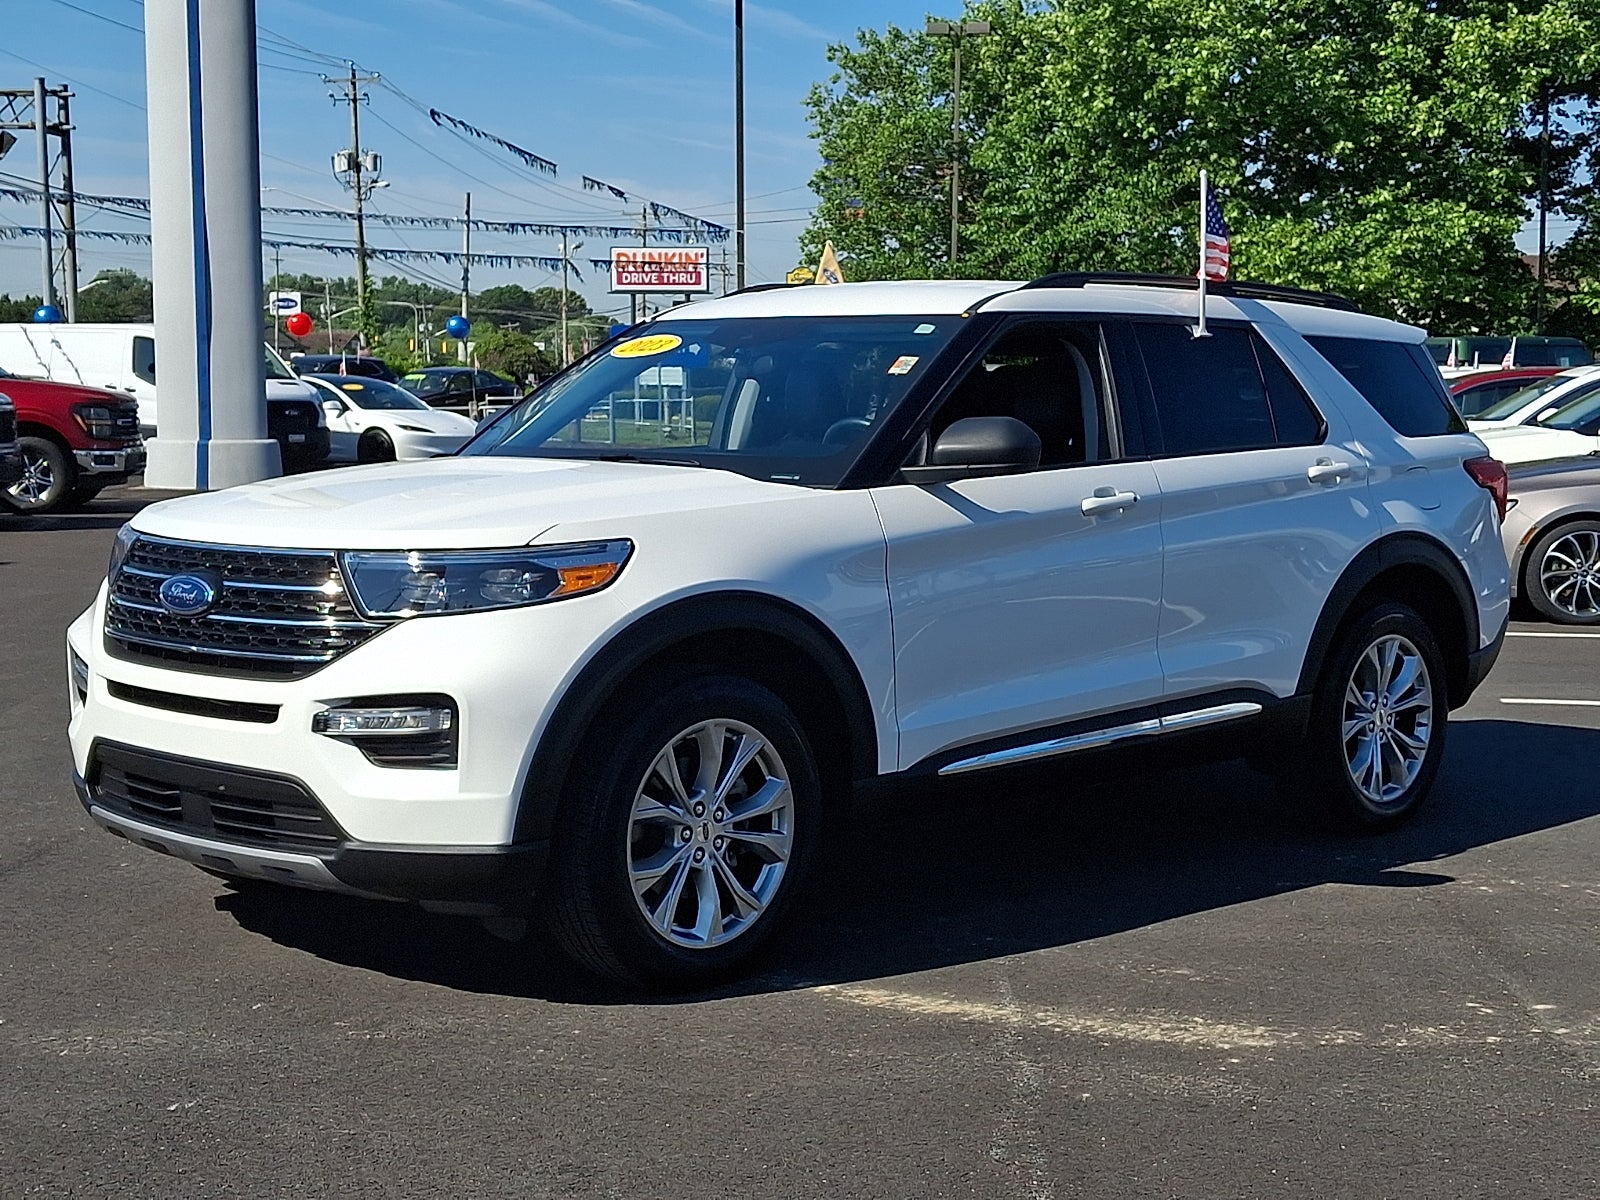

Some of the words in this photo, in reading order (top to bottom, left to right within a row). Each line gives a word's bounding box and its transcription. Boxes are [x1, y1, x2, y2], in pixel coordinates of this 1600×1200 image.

[622, 272, 659, 284] DRIVE
[661, 272, 696, 284] THRU
[170, 582, 198, 601] Ford
